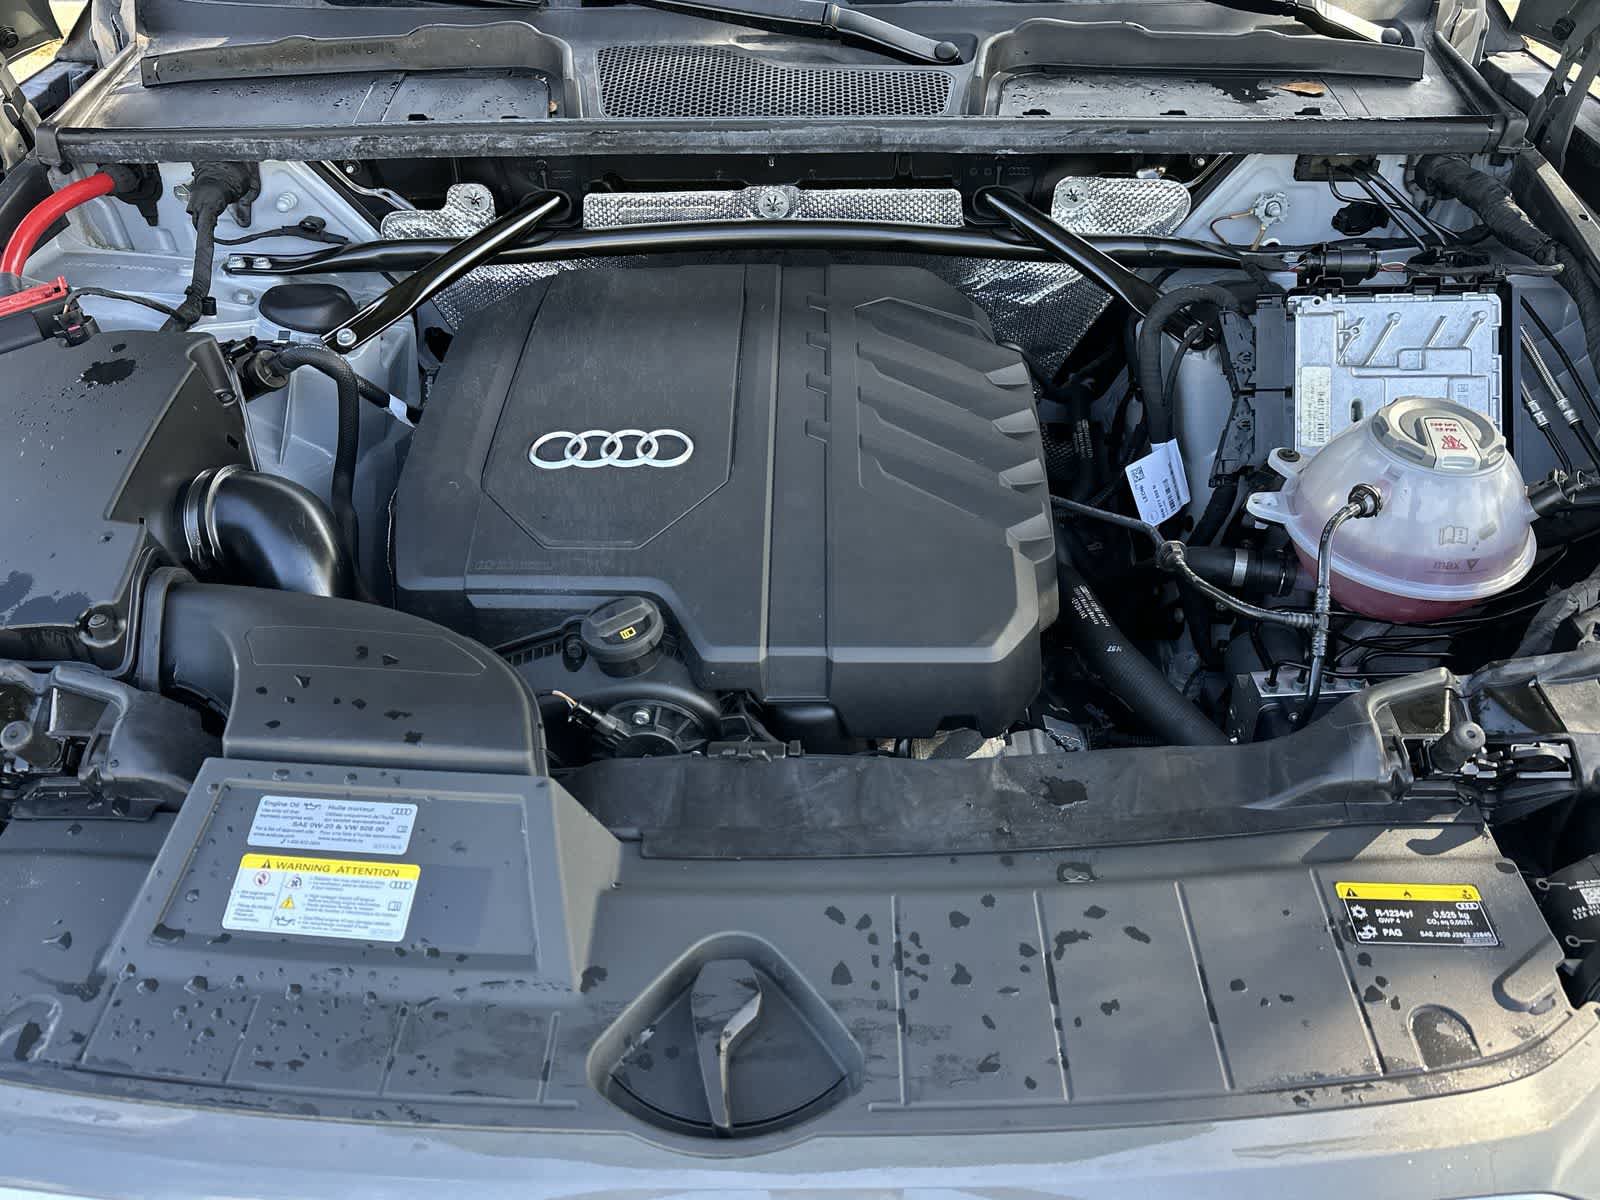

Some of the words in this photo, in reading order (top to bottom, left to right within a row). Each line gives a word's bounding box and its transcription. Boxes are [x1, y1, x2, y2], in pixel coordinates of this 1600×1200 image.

[1433, 560, 1460, 570] max
[263, 800, 287, 808] Engine
[275, 861, 330, 873] WARNING
[335, 864, 400, 877] ATTENTION
[1459, 911, 1470, 920] kg
[1383, 928, 1403, 937] PAG
